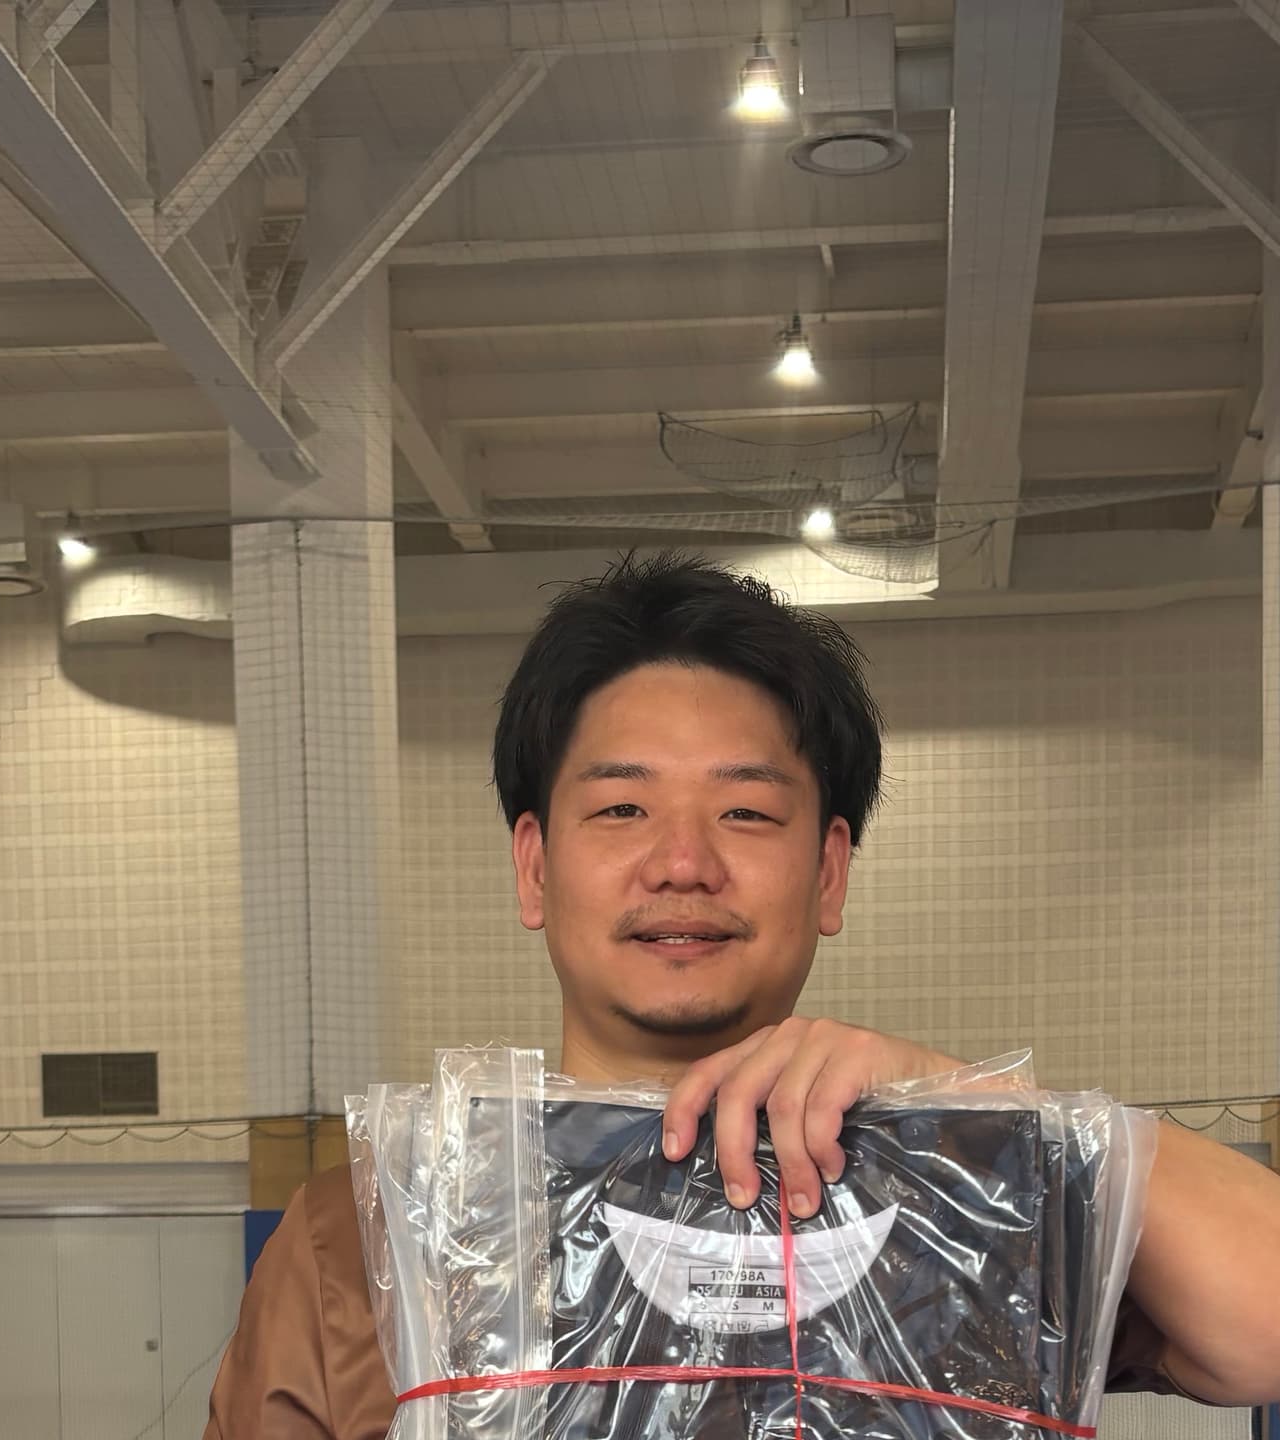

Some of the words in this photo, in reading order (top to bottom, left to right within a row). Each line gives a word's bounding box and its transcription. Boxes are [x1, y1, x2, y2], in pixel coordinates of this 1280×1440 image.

[710, 1269, 766, 1282] 170/98A
[755, 1286, 782, 1298] ASIA
[732, 1302, 740, 1311] S
[762, 1302, 775, 1311] M
